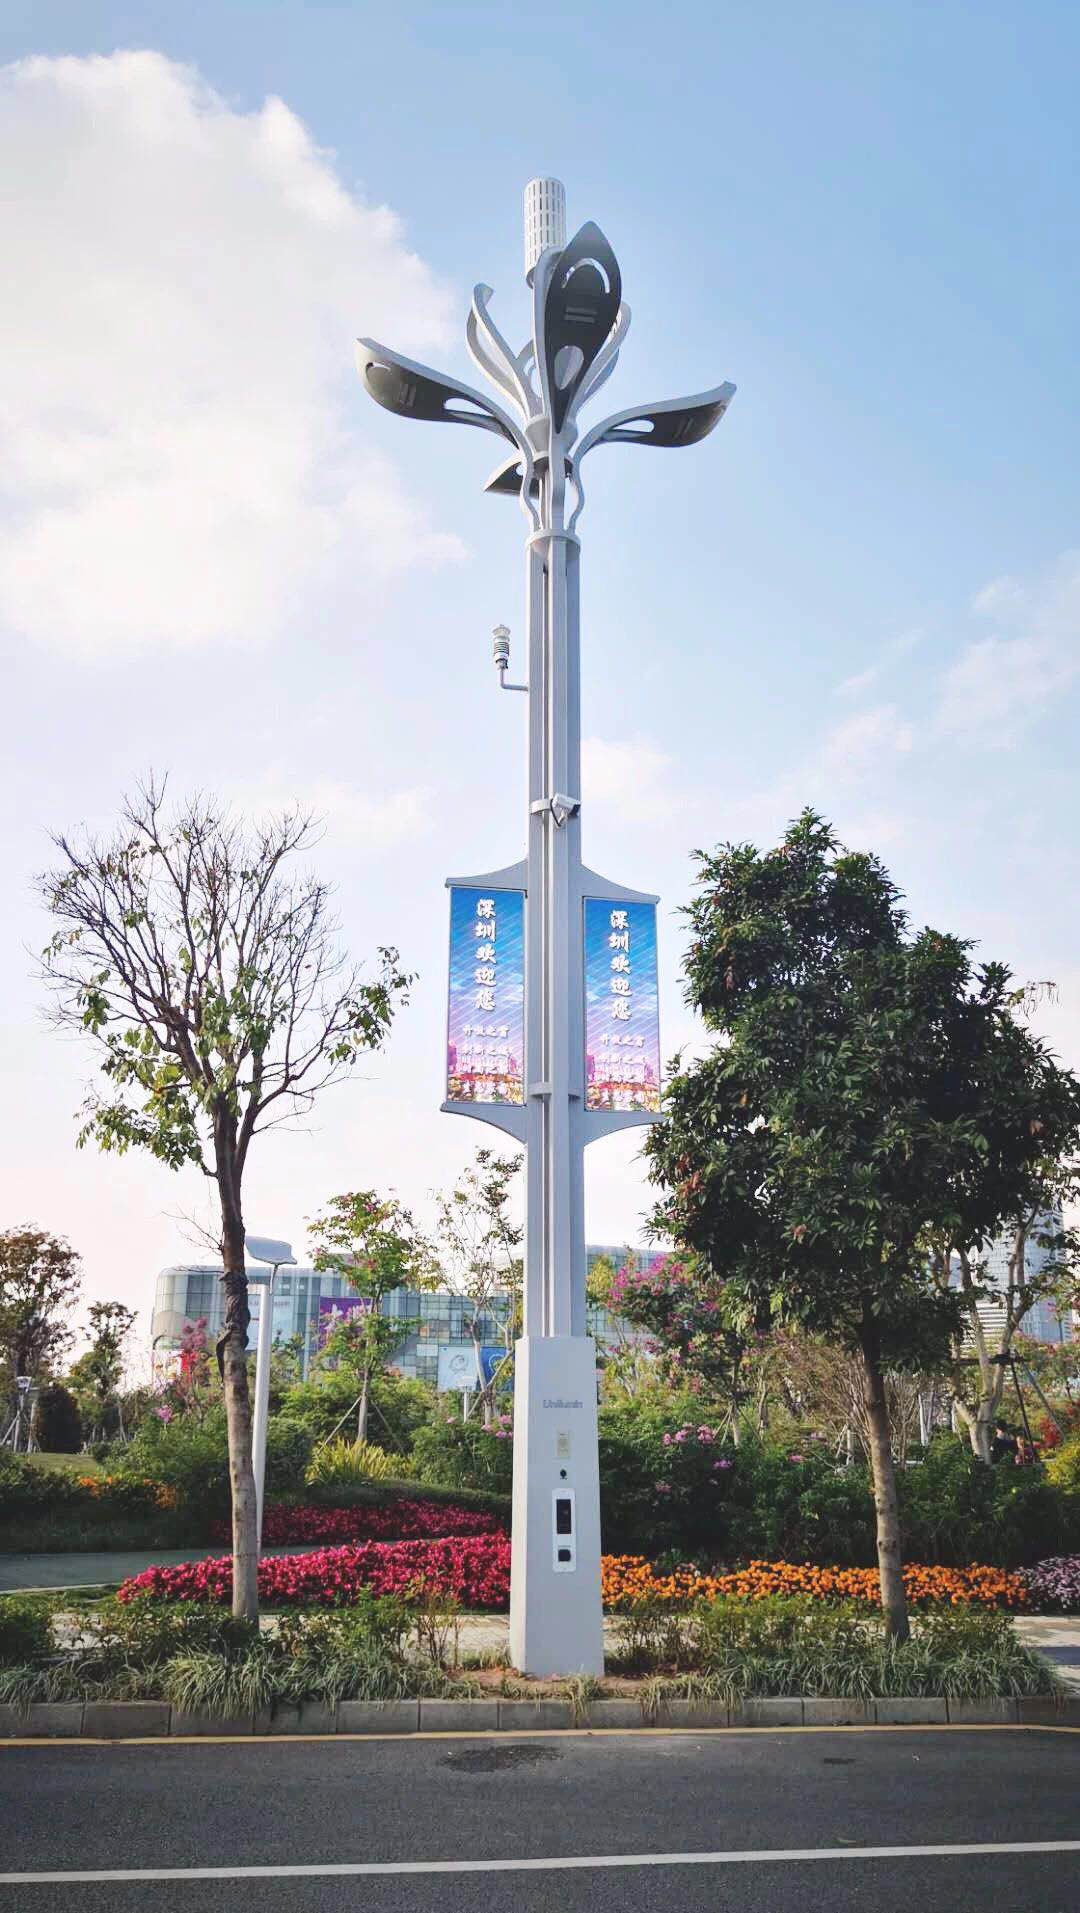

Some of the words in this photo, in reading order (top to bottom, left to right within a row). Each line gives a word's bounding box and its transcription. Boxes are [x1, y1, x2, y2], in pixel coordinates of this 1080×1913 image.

[475, 898, 497, 1011] 深圳欢迎您
[608, 909, 632, 1021] 深圳欢迎您
